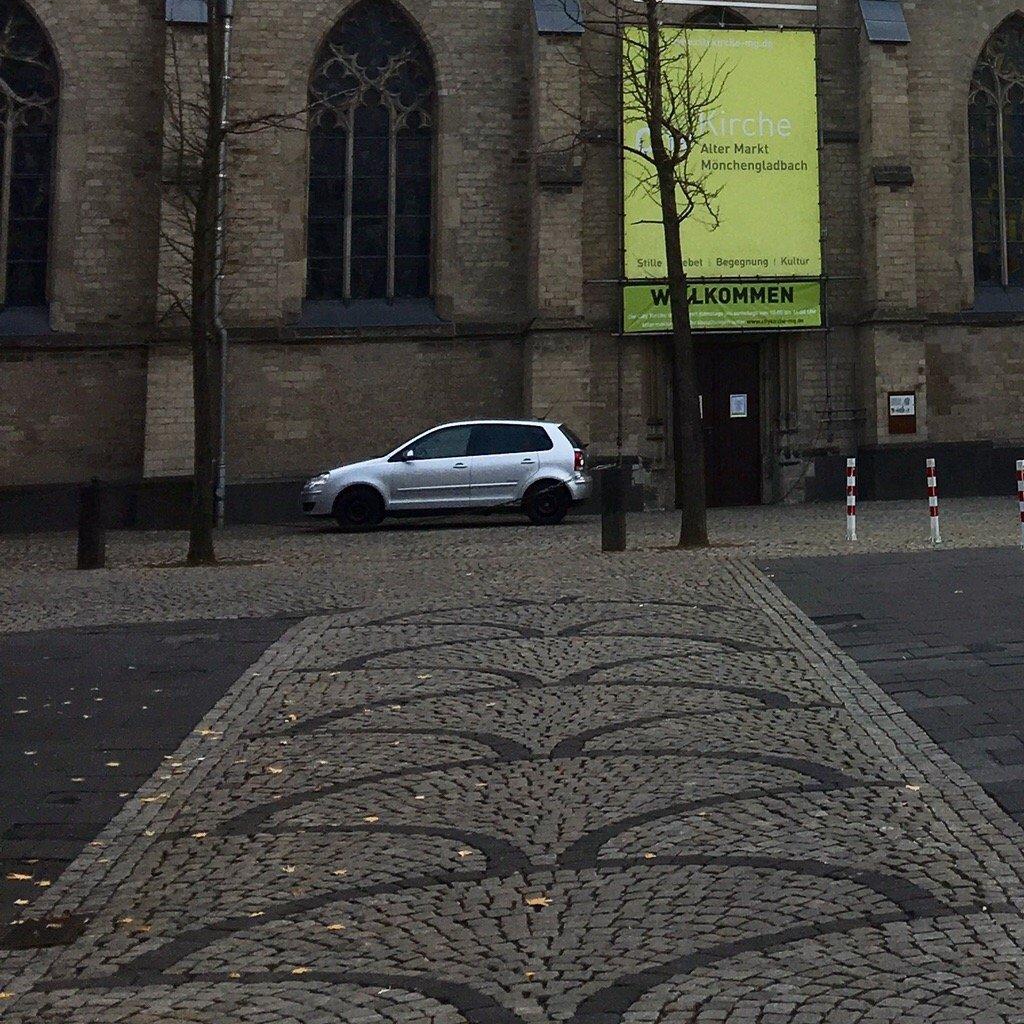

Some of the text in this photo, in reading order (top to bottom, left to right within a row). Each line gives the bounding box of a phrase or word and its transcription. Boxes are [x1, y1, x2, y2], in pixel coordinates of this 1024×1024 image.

[700, 110, 793, 139] Kirche
[701, 143, 770, 155] Alter Markt
[636, 258, 663, 268] Stille
[716, 256, 769, 269] Begegnung
[780, 255, 810, 267] Kultur
[651, 286, 794, 306] WLKOMMEN
